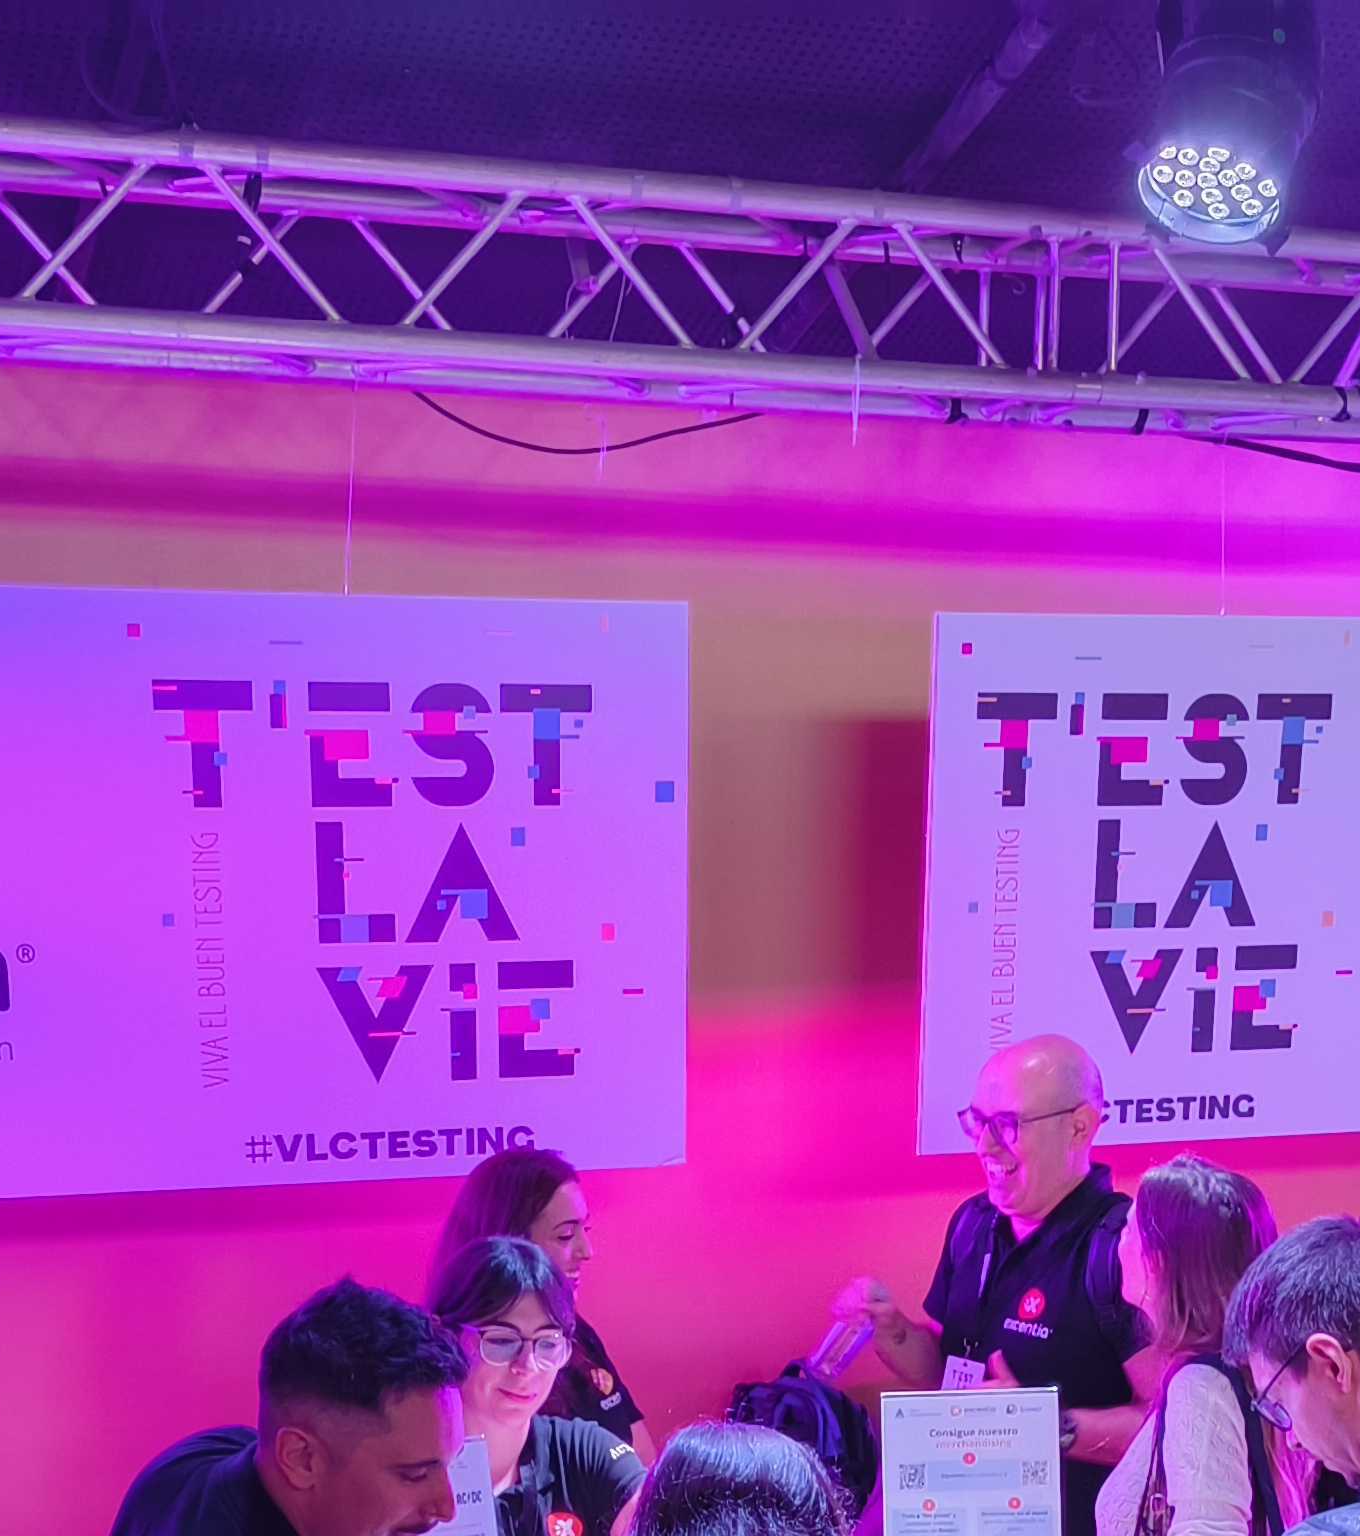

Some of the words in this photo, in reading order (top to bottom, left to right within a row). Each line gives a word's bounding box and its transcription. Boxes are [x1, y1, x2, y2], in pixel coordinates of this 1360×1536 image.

[190, 832, 223, 928] TESTING
[313, 821, 522, 944] LA
[994, 828, 1020, 916] TESTING
[1092, 819, 1257, 929] LA
[195, 938, 226, 997] BUEN
[992, 923, 1018, 978] BUEN
[199, 1004, 227, 1028] EL
[991, 984, 1015, 1006] EL
[200, 1036, 230, 1088] VIVA
[245, 1125, 536, 1163] #VLCTESTING
[928, 1427, 976, 1439] Consigue
[978, 1427, 1019, 1437] nuestro
